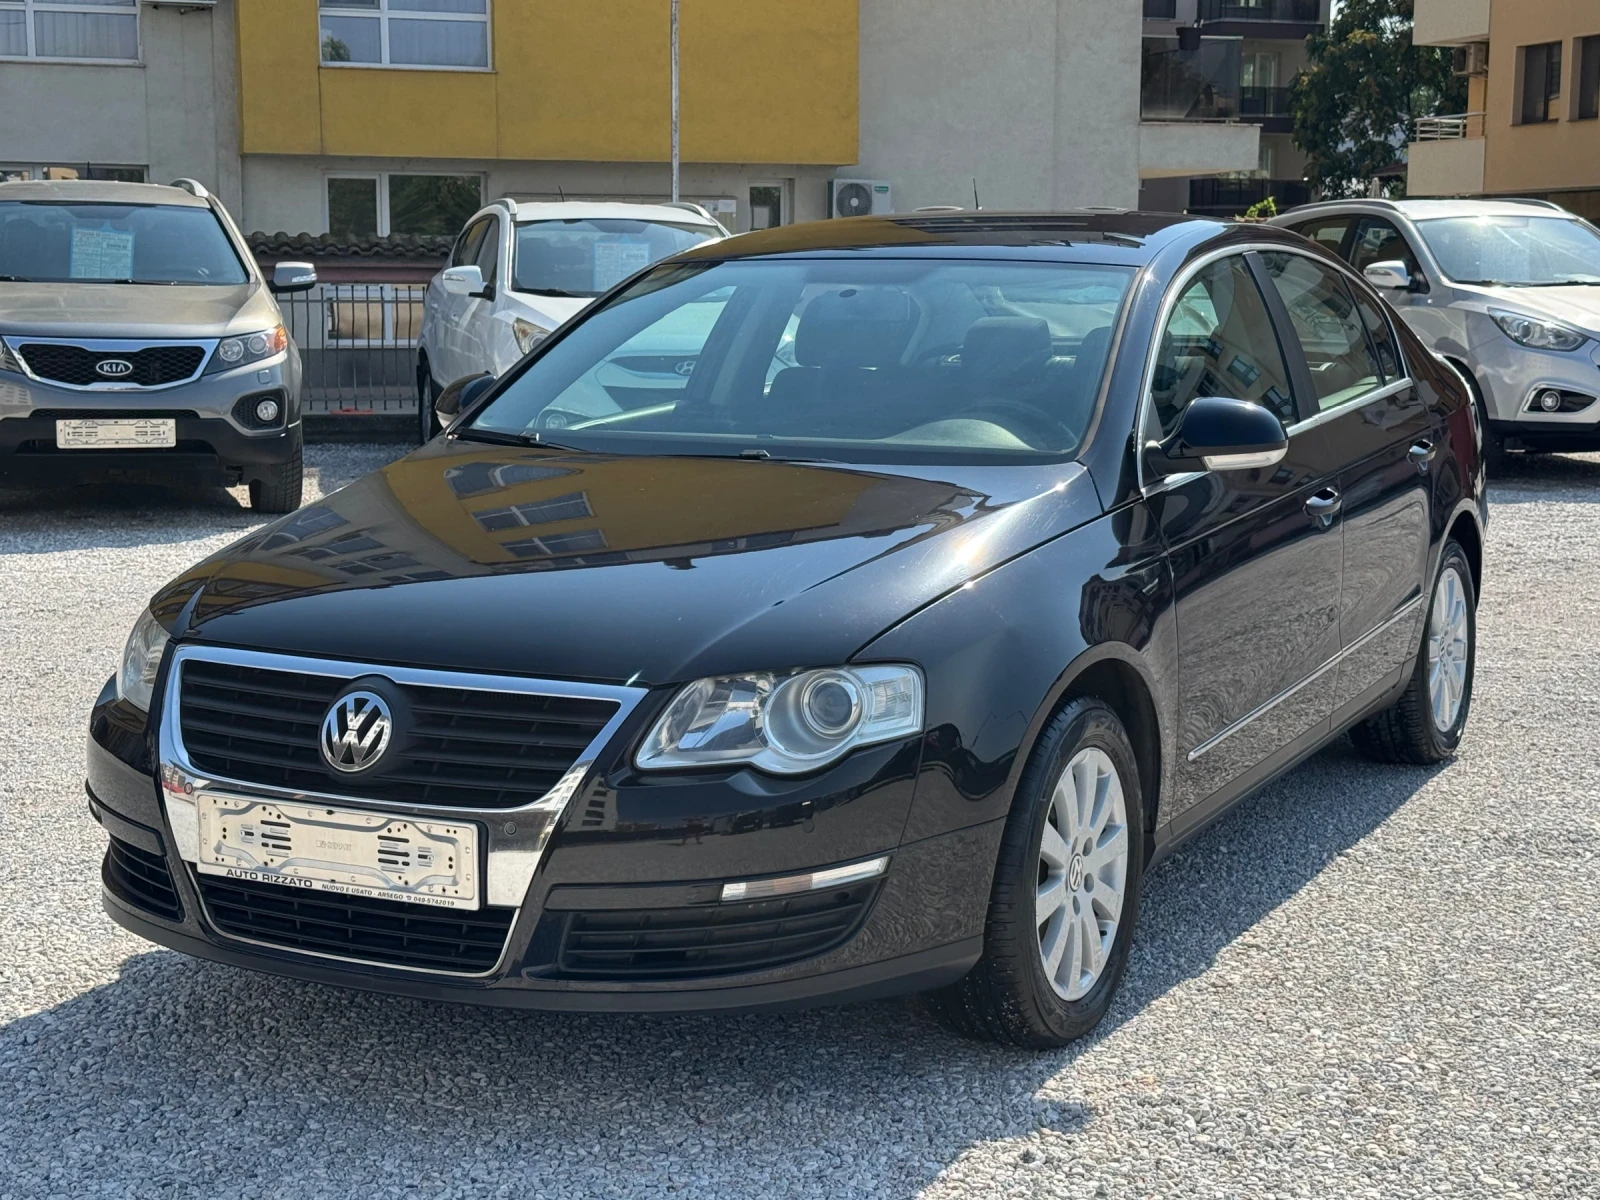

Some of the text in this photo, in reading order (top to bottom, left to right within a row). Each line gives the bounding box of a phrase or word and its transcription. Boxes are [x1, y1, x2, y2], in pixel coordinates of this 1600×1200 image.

[103, 363, 126, 372] KIA
[226, 869, 313, 888] AUTO RIZZATO
[322, 883, 345, 892] NUOVO
[351, 887, 373, 896] USATO
[377, 891, 404, 900] ARSEGO
